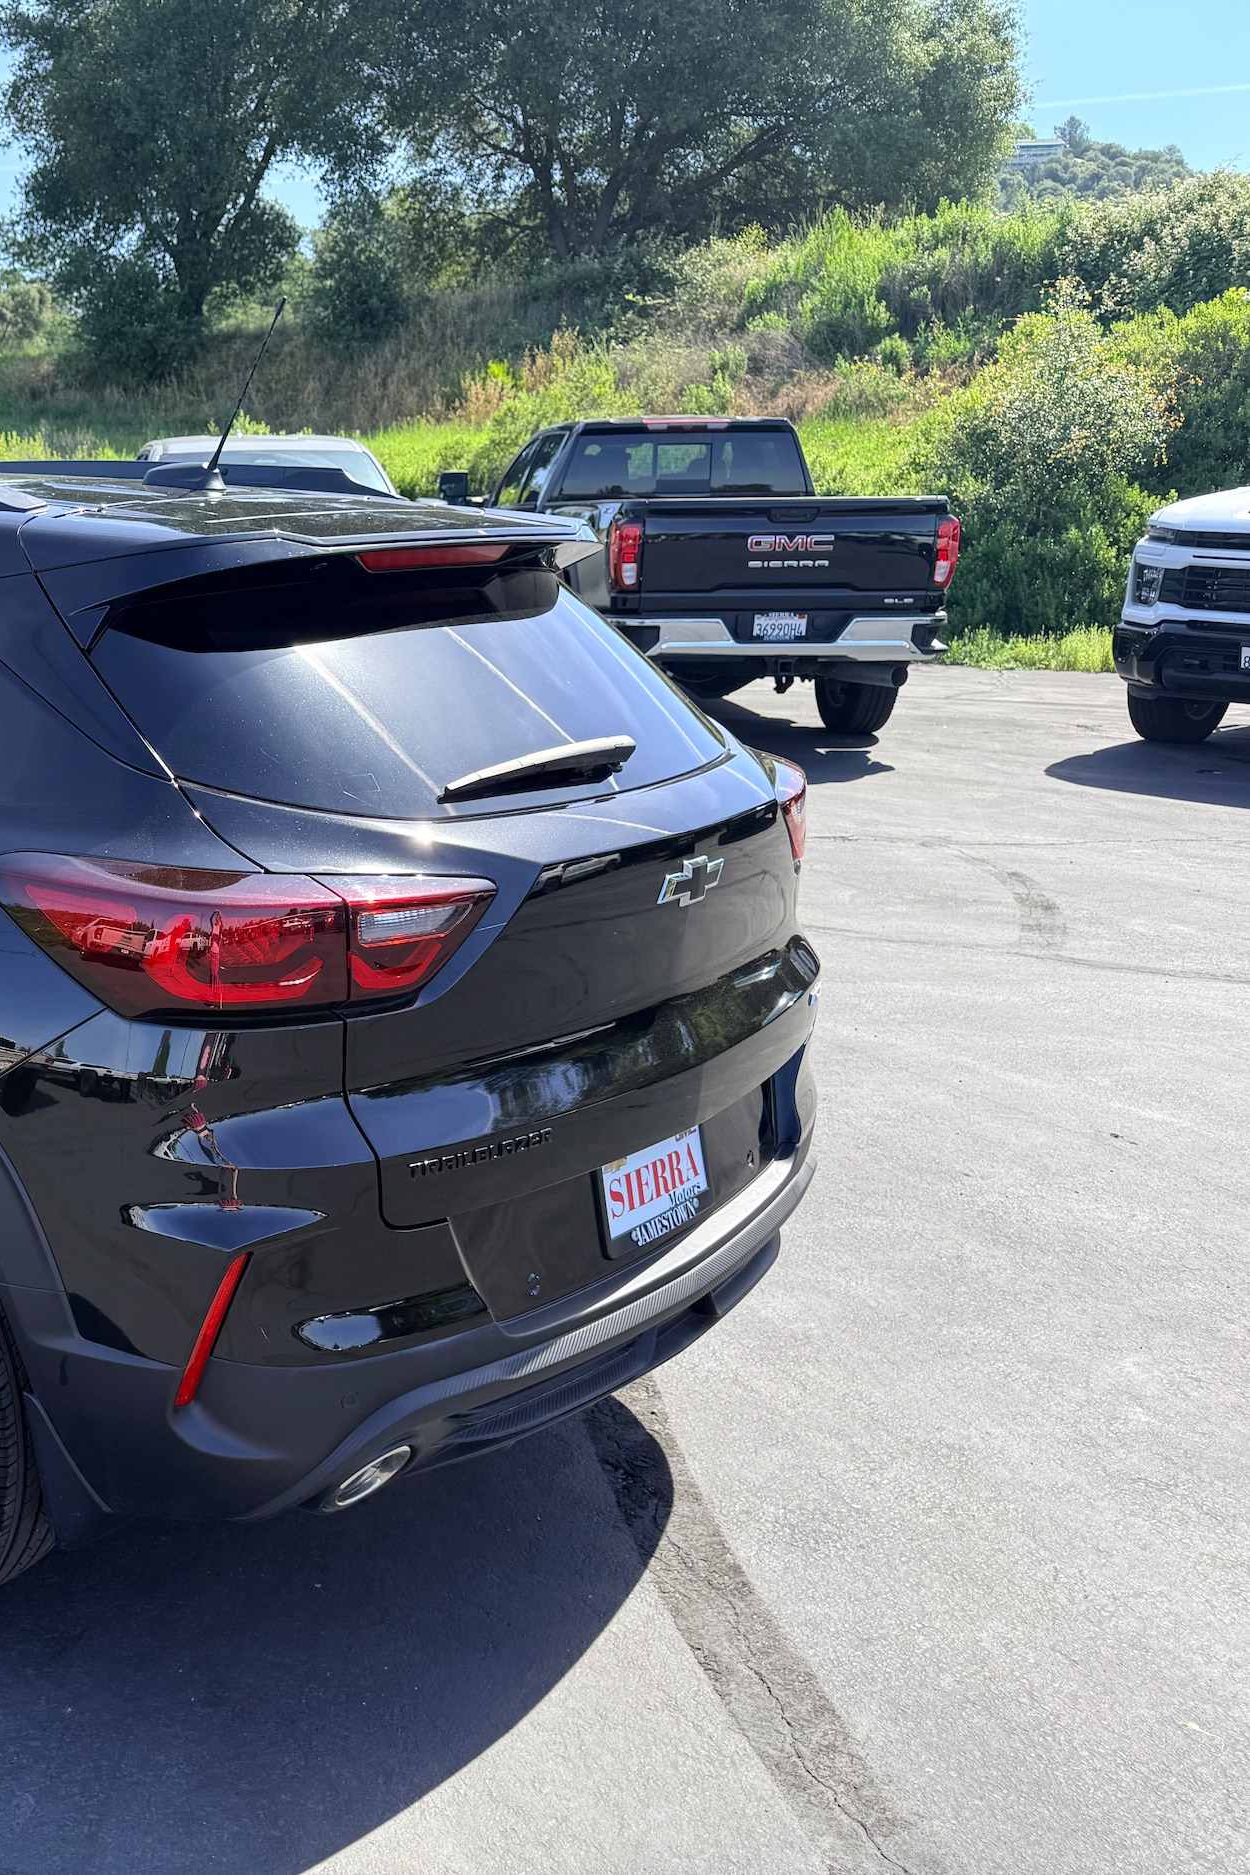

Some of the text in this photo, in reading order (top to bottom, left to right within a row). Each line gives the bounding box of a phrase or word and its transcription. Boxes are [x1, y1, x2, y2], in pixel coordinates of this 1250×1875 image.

[747, 535, 835, 551] GMC
[747, 560, 830, 568] SIERRA
[408, 1127, 552, 1179] TRAILBLAZER
[609, 1142, 700, 1220] SIERRA
[668, 1182, 701, 1208] Motors
[634, 1201, 698, 1247] JAMESTOWN
